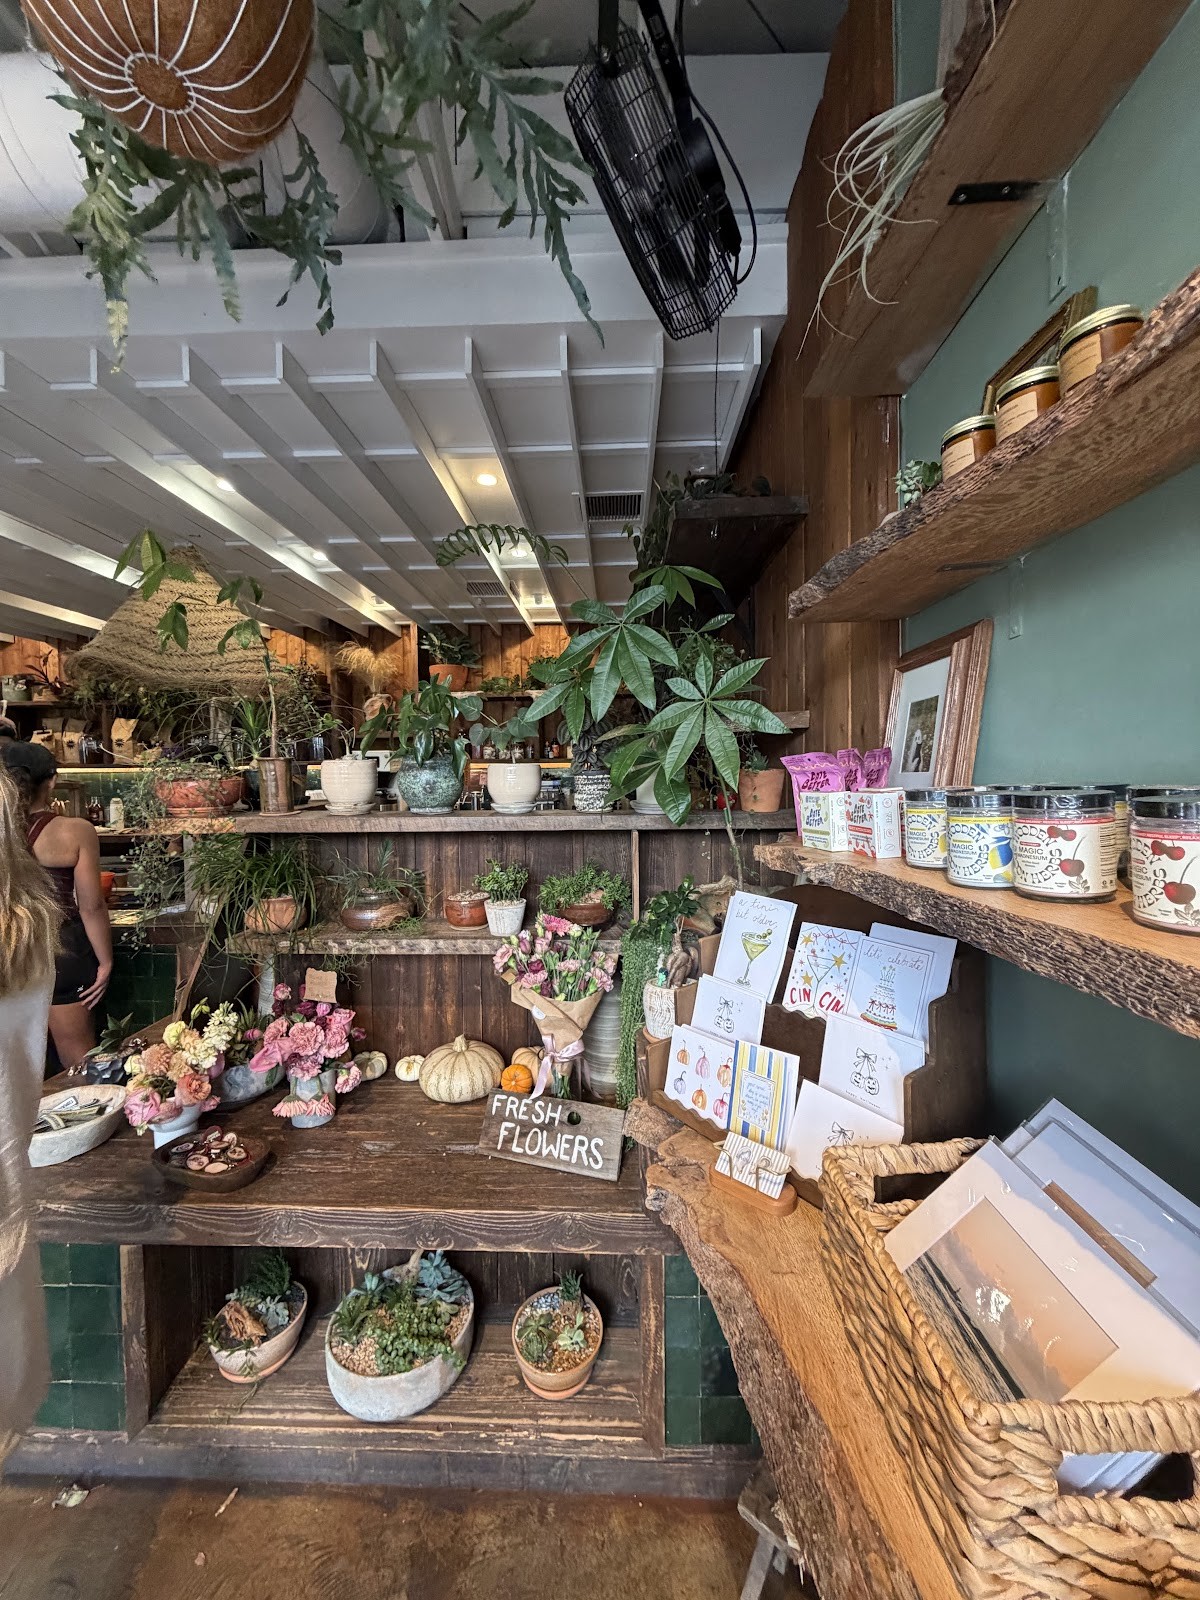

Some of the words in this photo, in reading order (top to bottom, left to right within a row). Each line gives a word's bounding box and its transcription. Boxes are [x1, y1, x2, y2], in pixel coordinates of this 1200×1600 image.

[951, 843, 974, 852] MAGIC
[962, 844, 989, 877] HERBS
[1018, 846, 1044, 855] MAGIC
[1030, 848, 1063, 885] HERBS
[888, 951, 925, 971] celebrate
[790, 987, 812, 1005] CIN
[818, 991, 846, 1014] CIN
[491, 1094, 563, 1127] FRESH
[496, 1121, 605, 1170] FLOWERS
